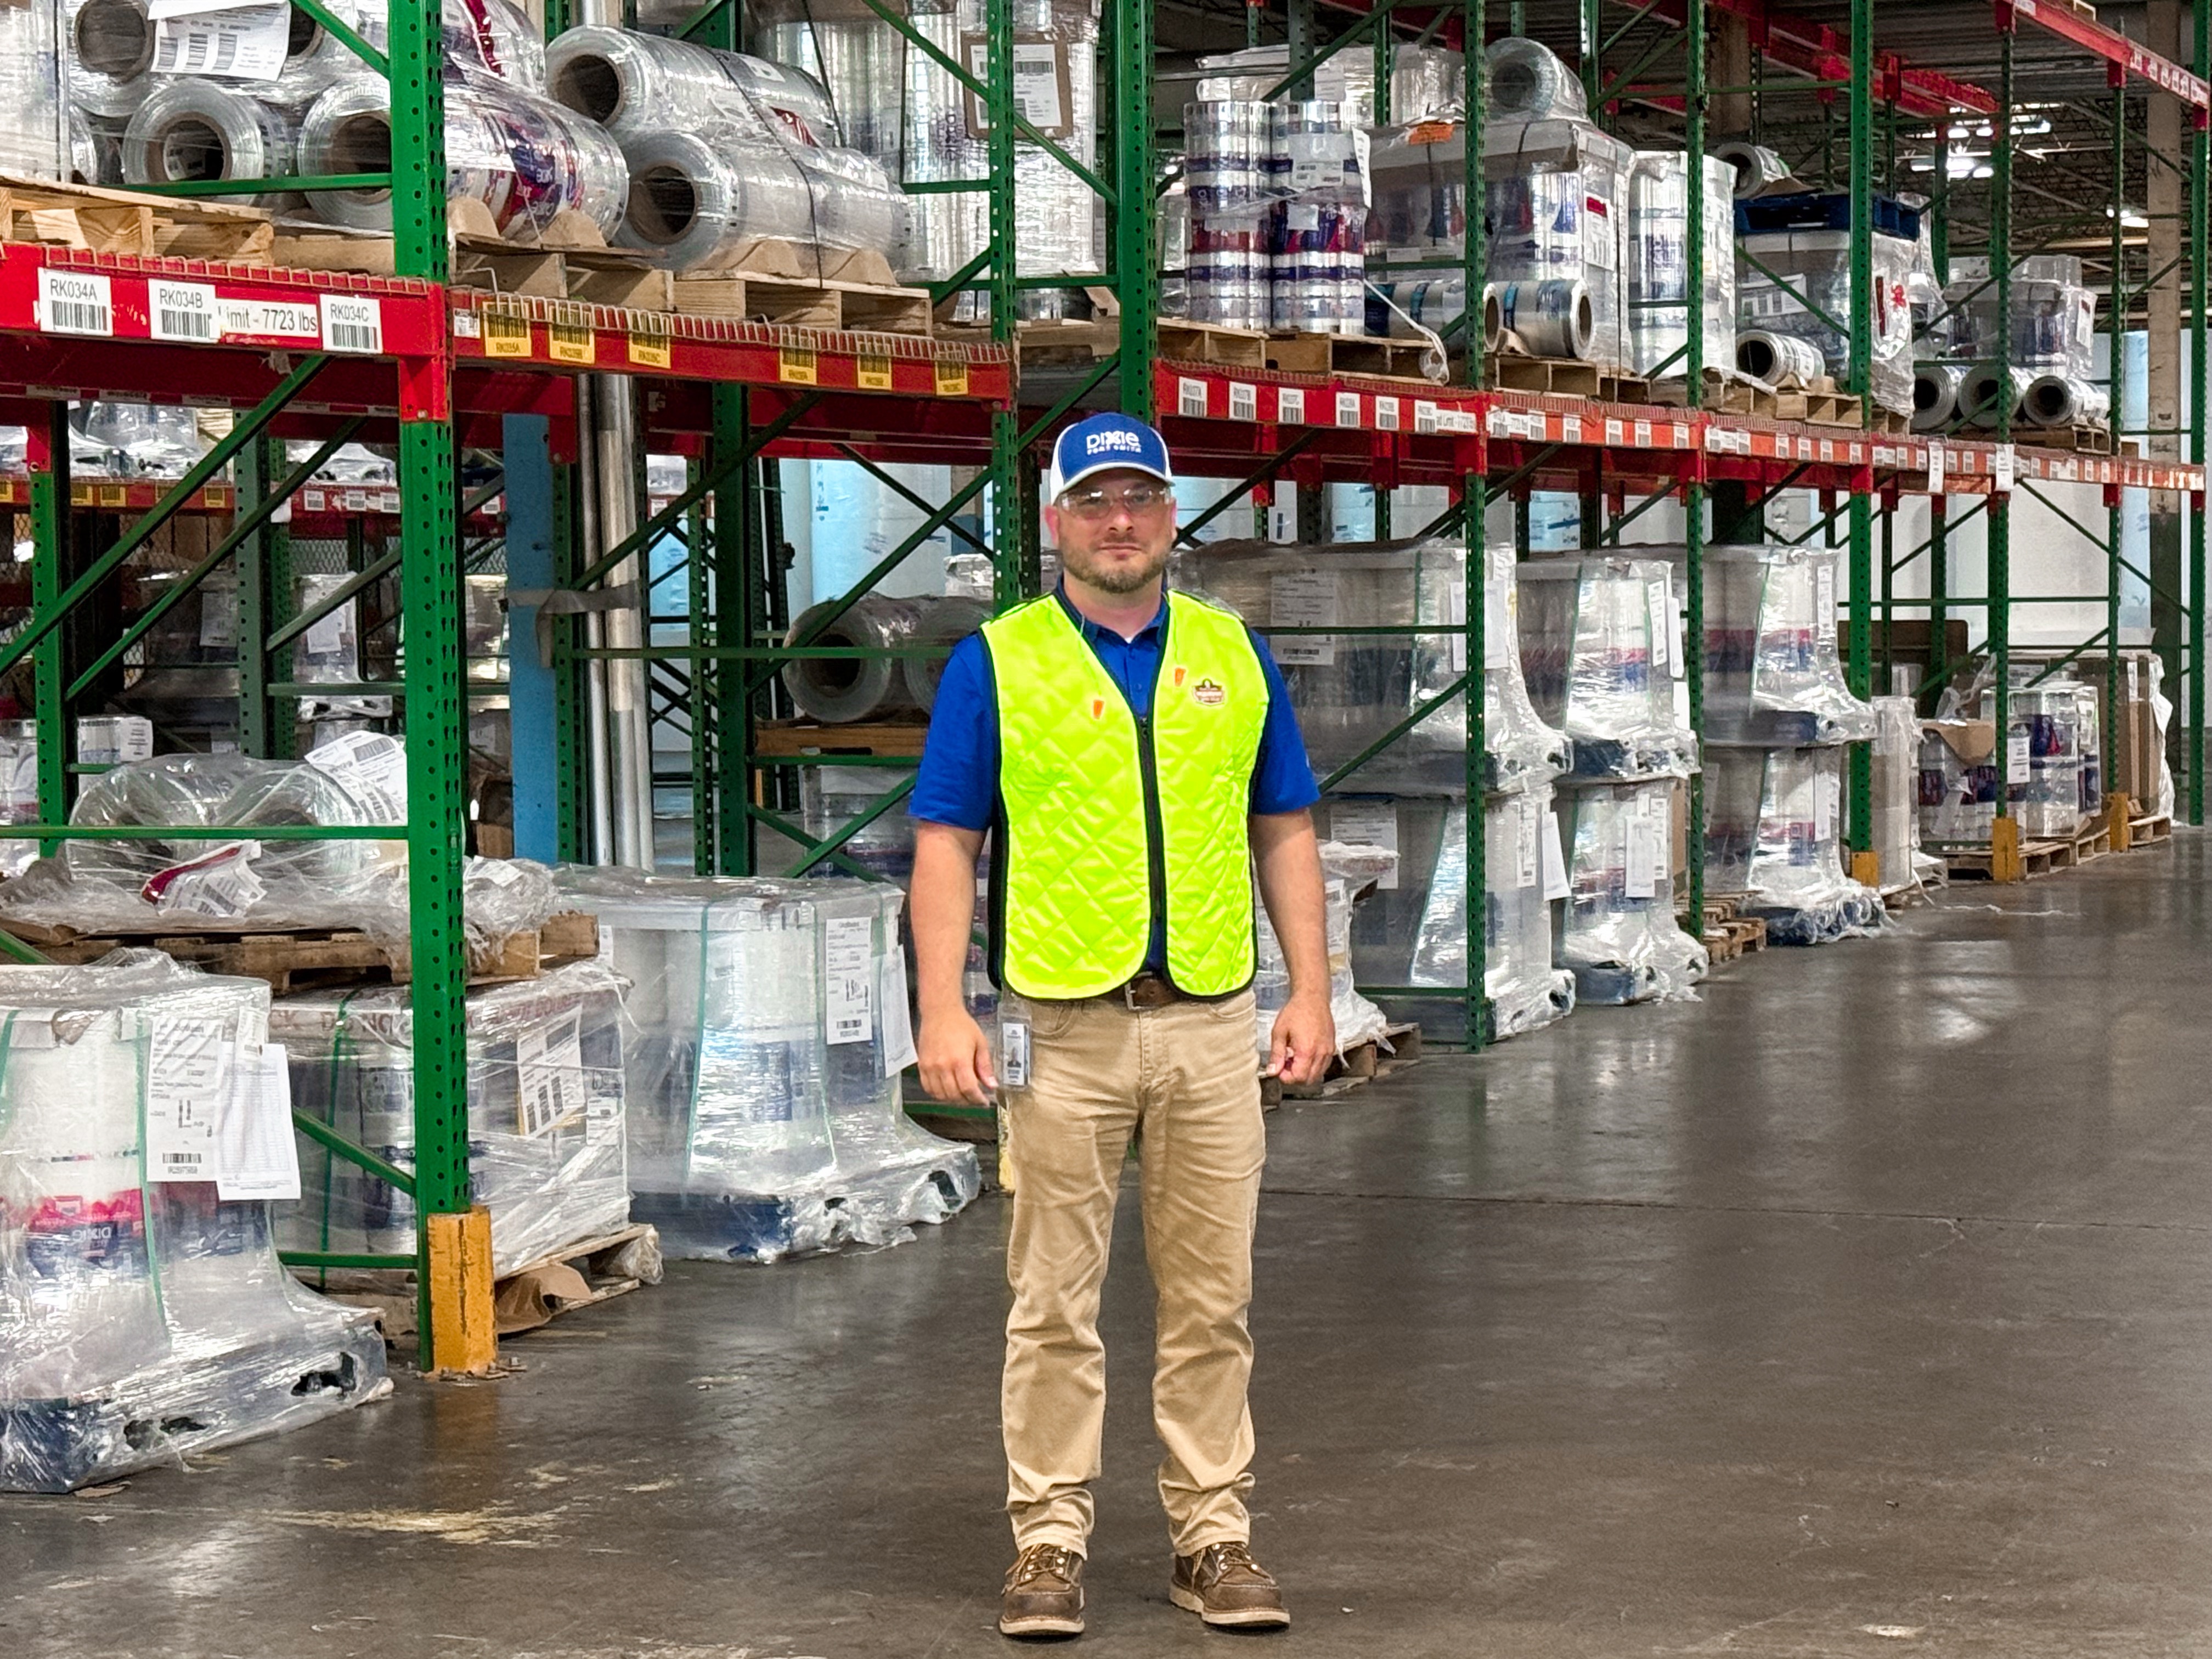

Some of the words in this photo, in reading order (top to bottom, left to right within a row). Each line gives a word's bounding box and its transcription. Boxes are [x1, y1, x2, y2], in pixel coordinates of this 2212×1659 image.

[50, 278, 98, 301] RK034A
[159, 288, 203, 308] RK034B
[262, 308, 295, 331] 7723
[298, 311, 317, 332] lbs
[330, 303, 369, 322] RK034C
